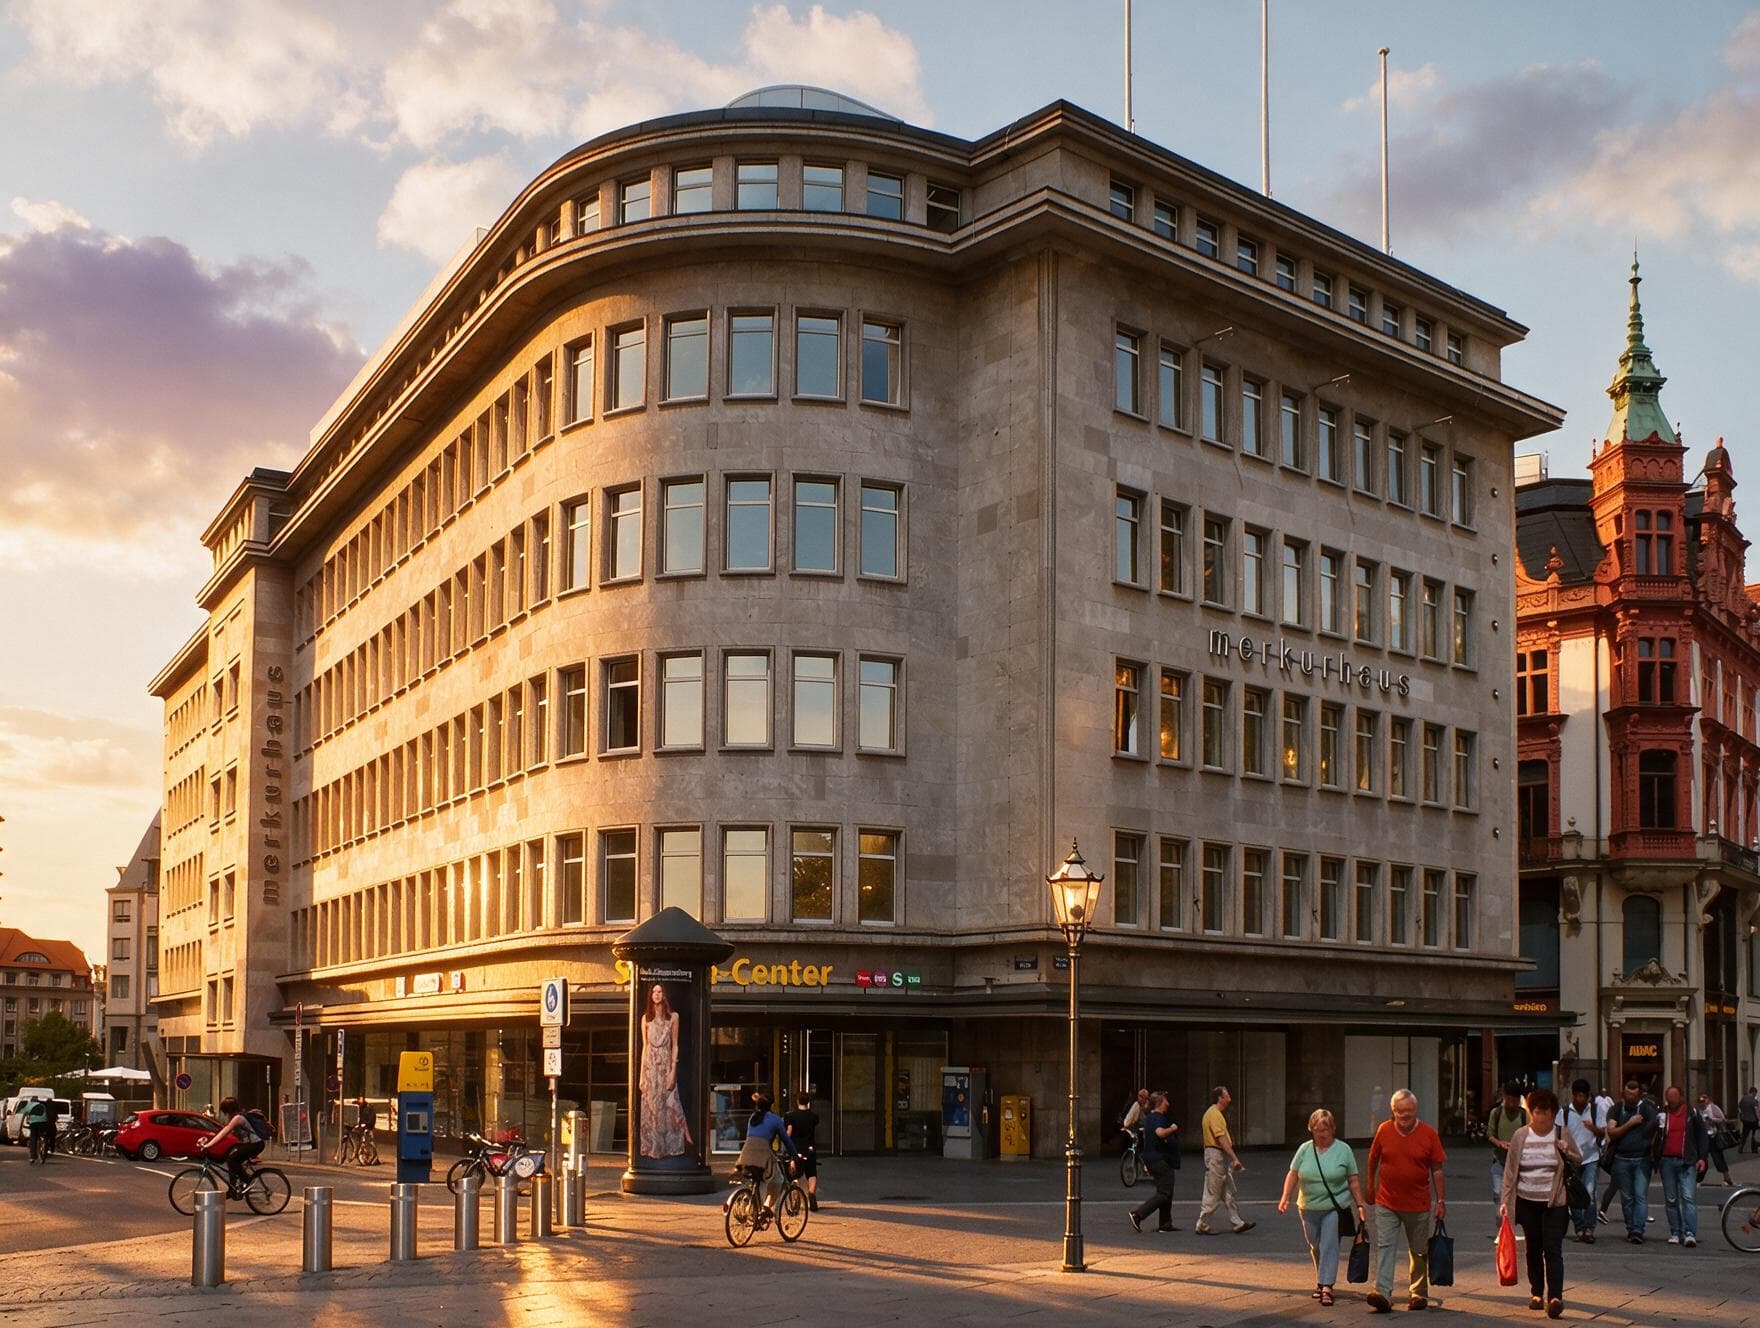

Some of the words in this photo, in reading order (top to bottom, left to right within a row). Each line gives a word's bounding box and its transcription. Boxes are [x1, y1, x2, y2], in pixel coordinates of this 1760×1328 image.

[1208, 629, 1410, 697] merkurhaus
[260, 665, 284, 906] merkurhaus
[892, 971, 903, 986] S
[1629, 1045, 1657, 1057] ADAC
